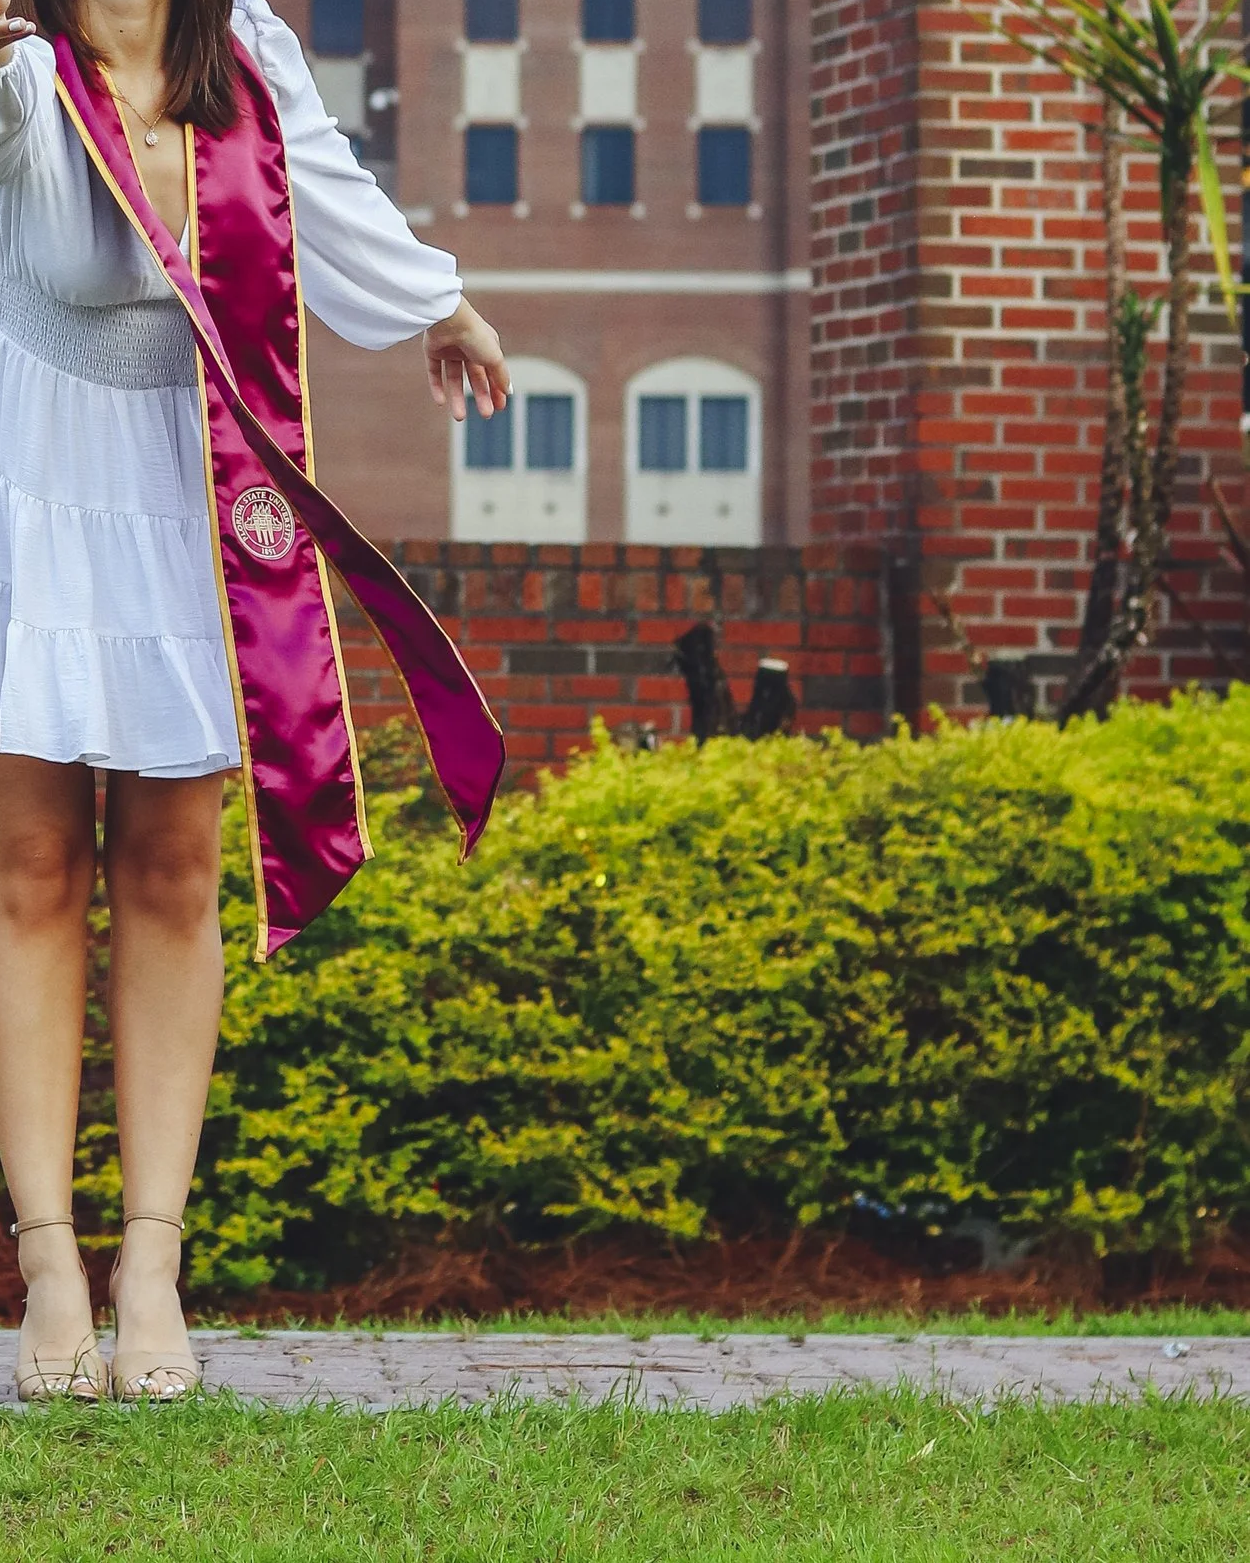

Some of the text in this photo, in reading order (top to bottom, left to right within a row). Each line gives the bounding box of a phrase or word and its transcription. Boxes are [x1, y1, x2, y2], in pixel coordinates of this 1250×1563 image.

[235, 491, 292, 544] FLORIDA STATE UNIVERSITY
[261, 547, 277, 556] 1851
